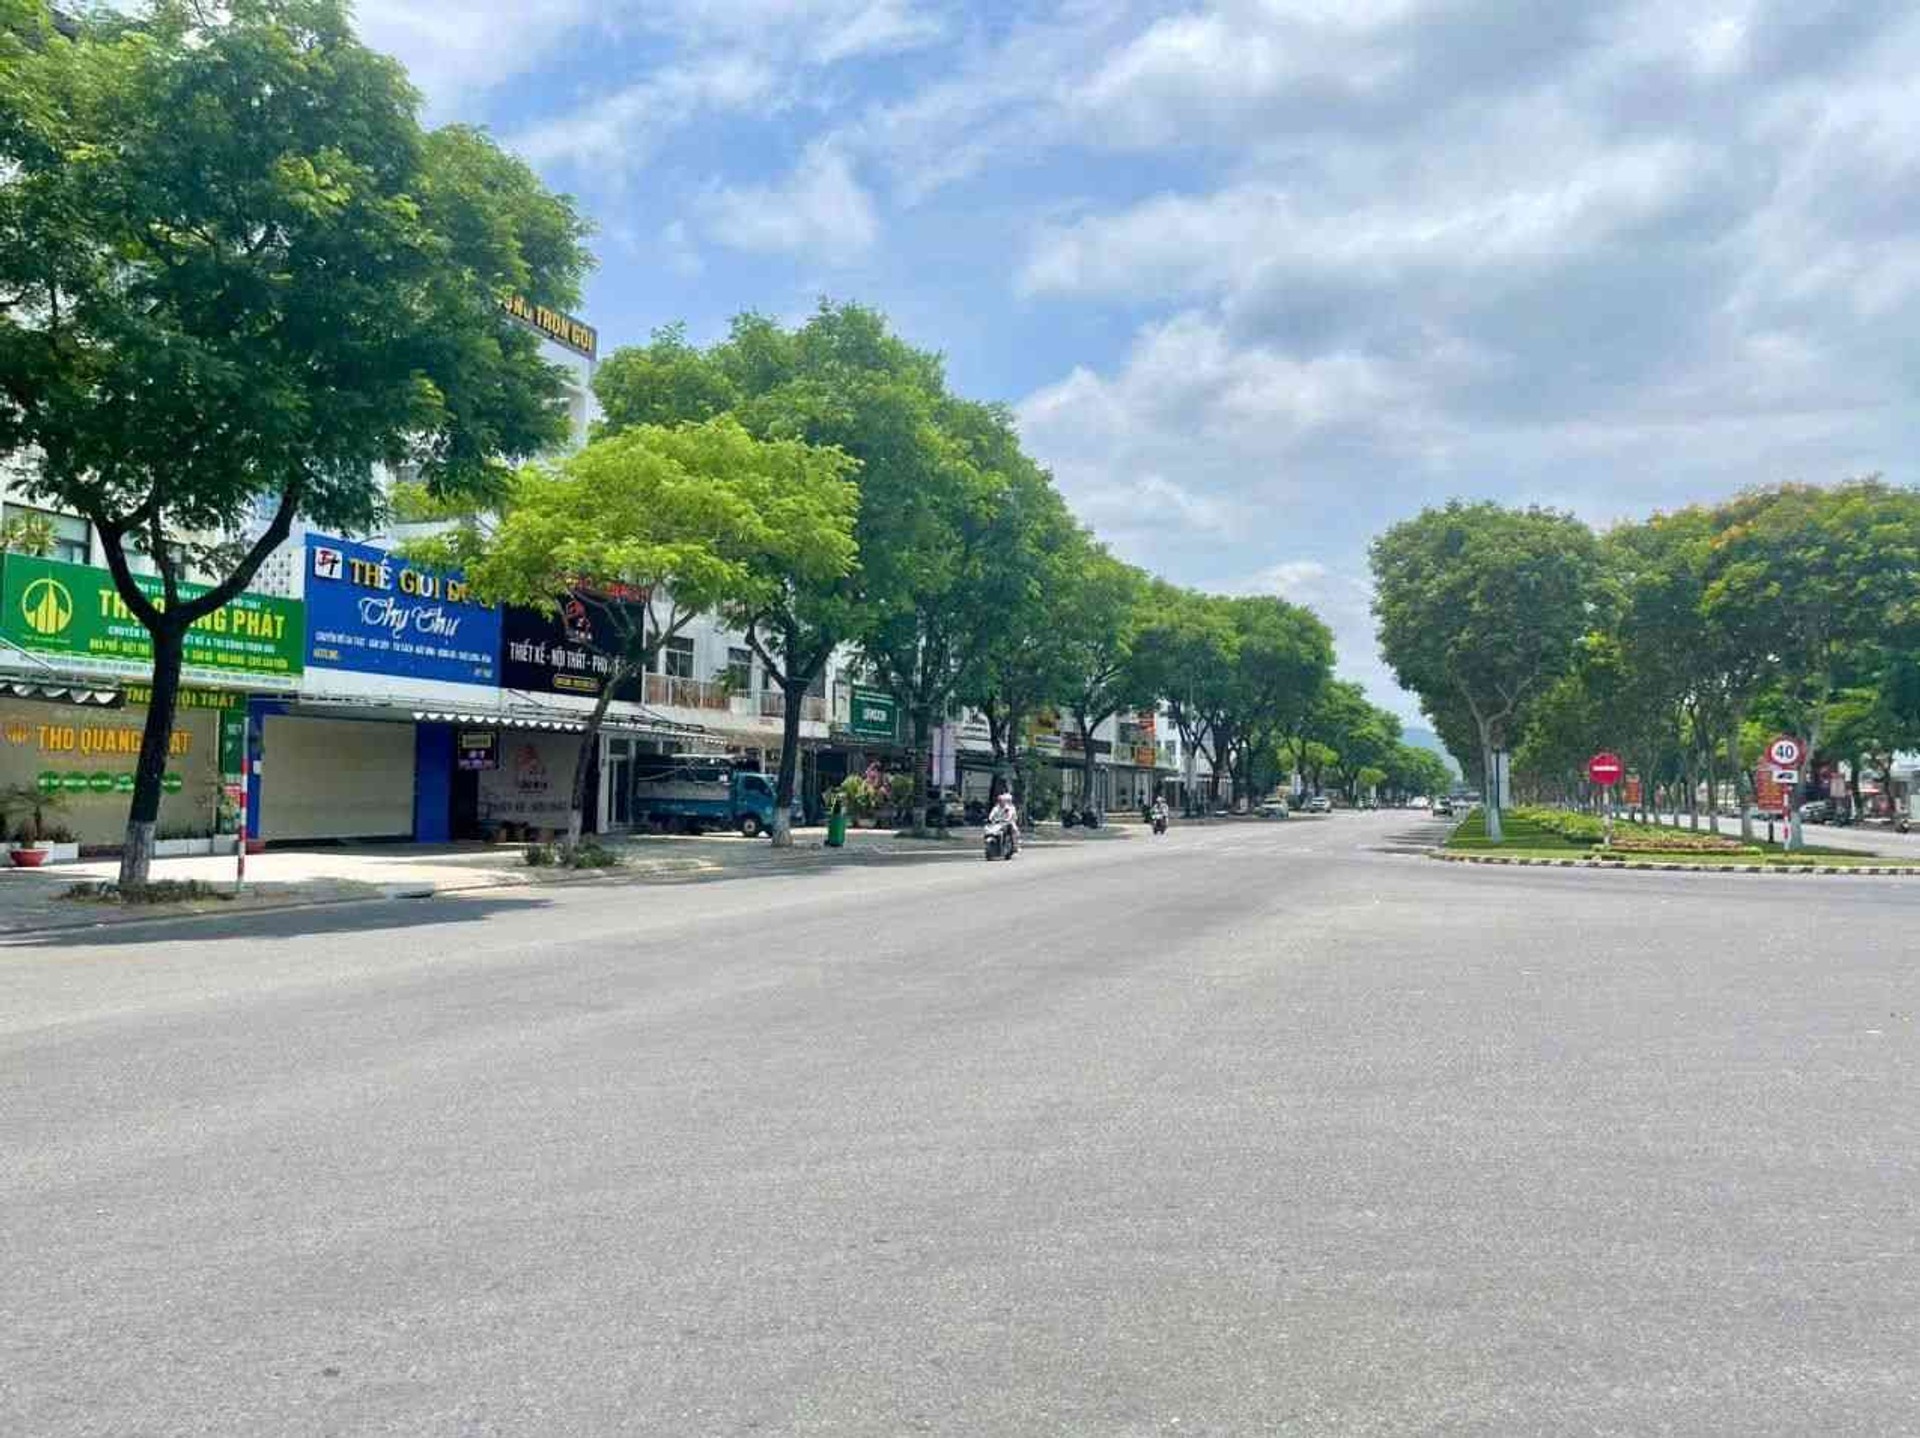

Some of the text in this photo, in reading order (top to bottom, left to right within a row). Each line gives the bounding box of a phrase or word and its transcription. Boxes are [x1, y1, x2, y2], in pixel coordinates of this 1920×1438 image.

[233, 607, 285, 640] PHÁT
[80, 727, 141, 756] QUANG
[1776, 745, 1794, 759] 40
